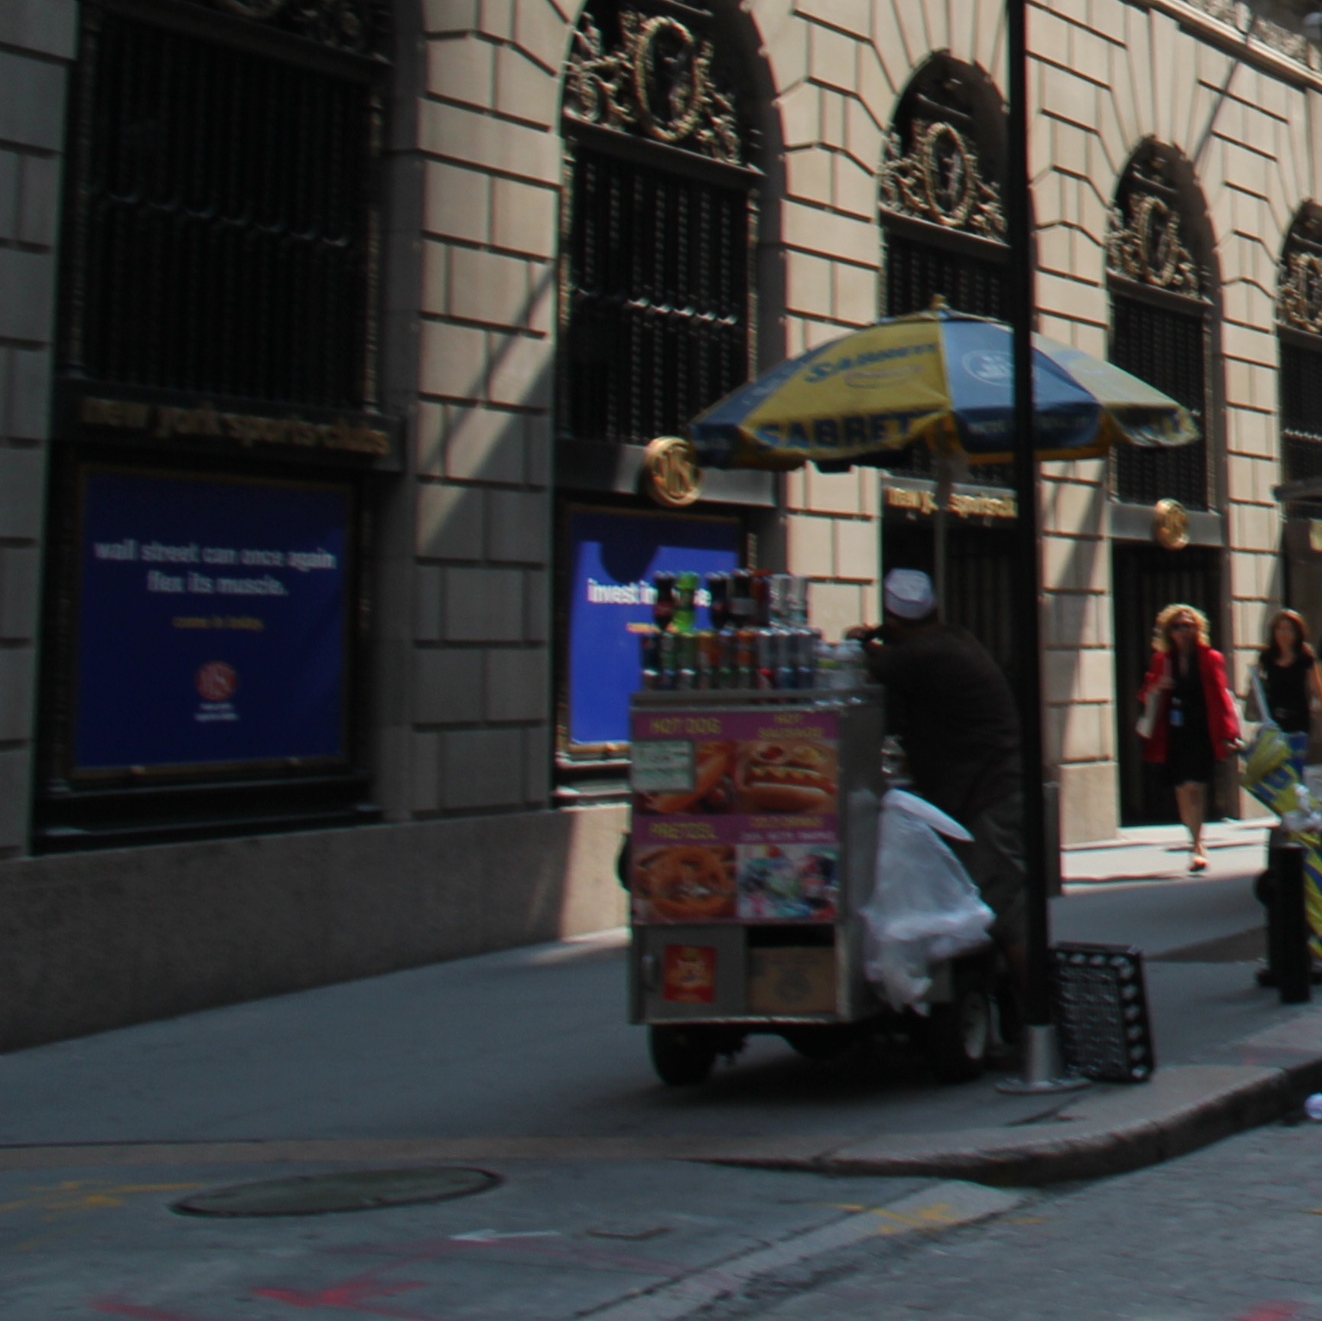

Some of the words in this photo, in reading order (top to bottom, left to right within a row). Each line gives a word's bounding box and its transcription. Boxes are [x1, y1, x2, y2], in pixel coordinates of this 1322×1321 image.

[93, 538, 139, 561] wall
[140, 541, 200, 563] street
[202, 546, 239, 565] can
[240, 549, 285, 567] once
[287, 547, 338, 572] again
[147, 569, 185, 593] flex
[187, 570, 216, 594] its
[587, 577, 638, 604] invest
